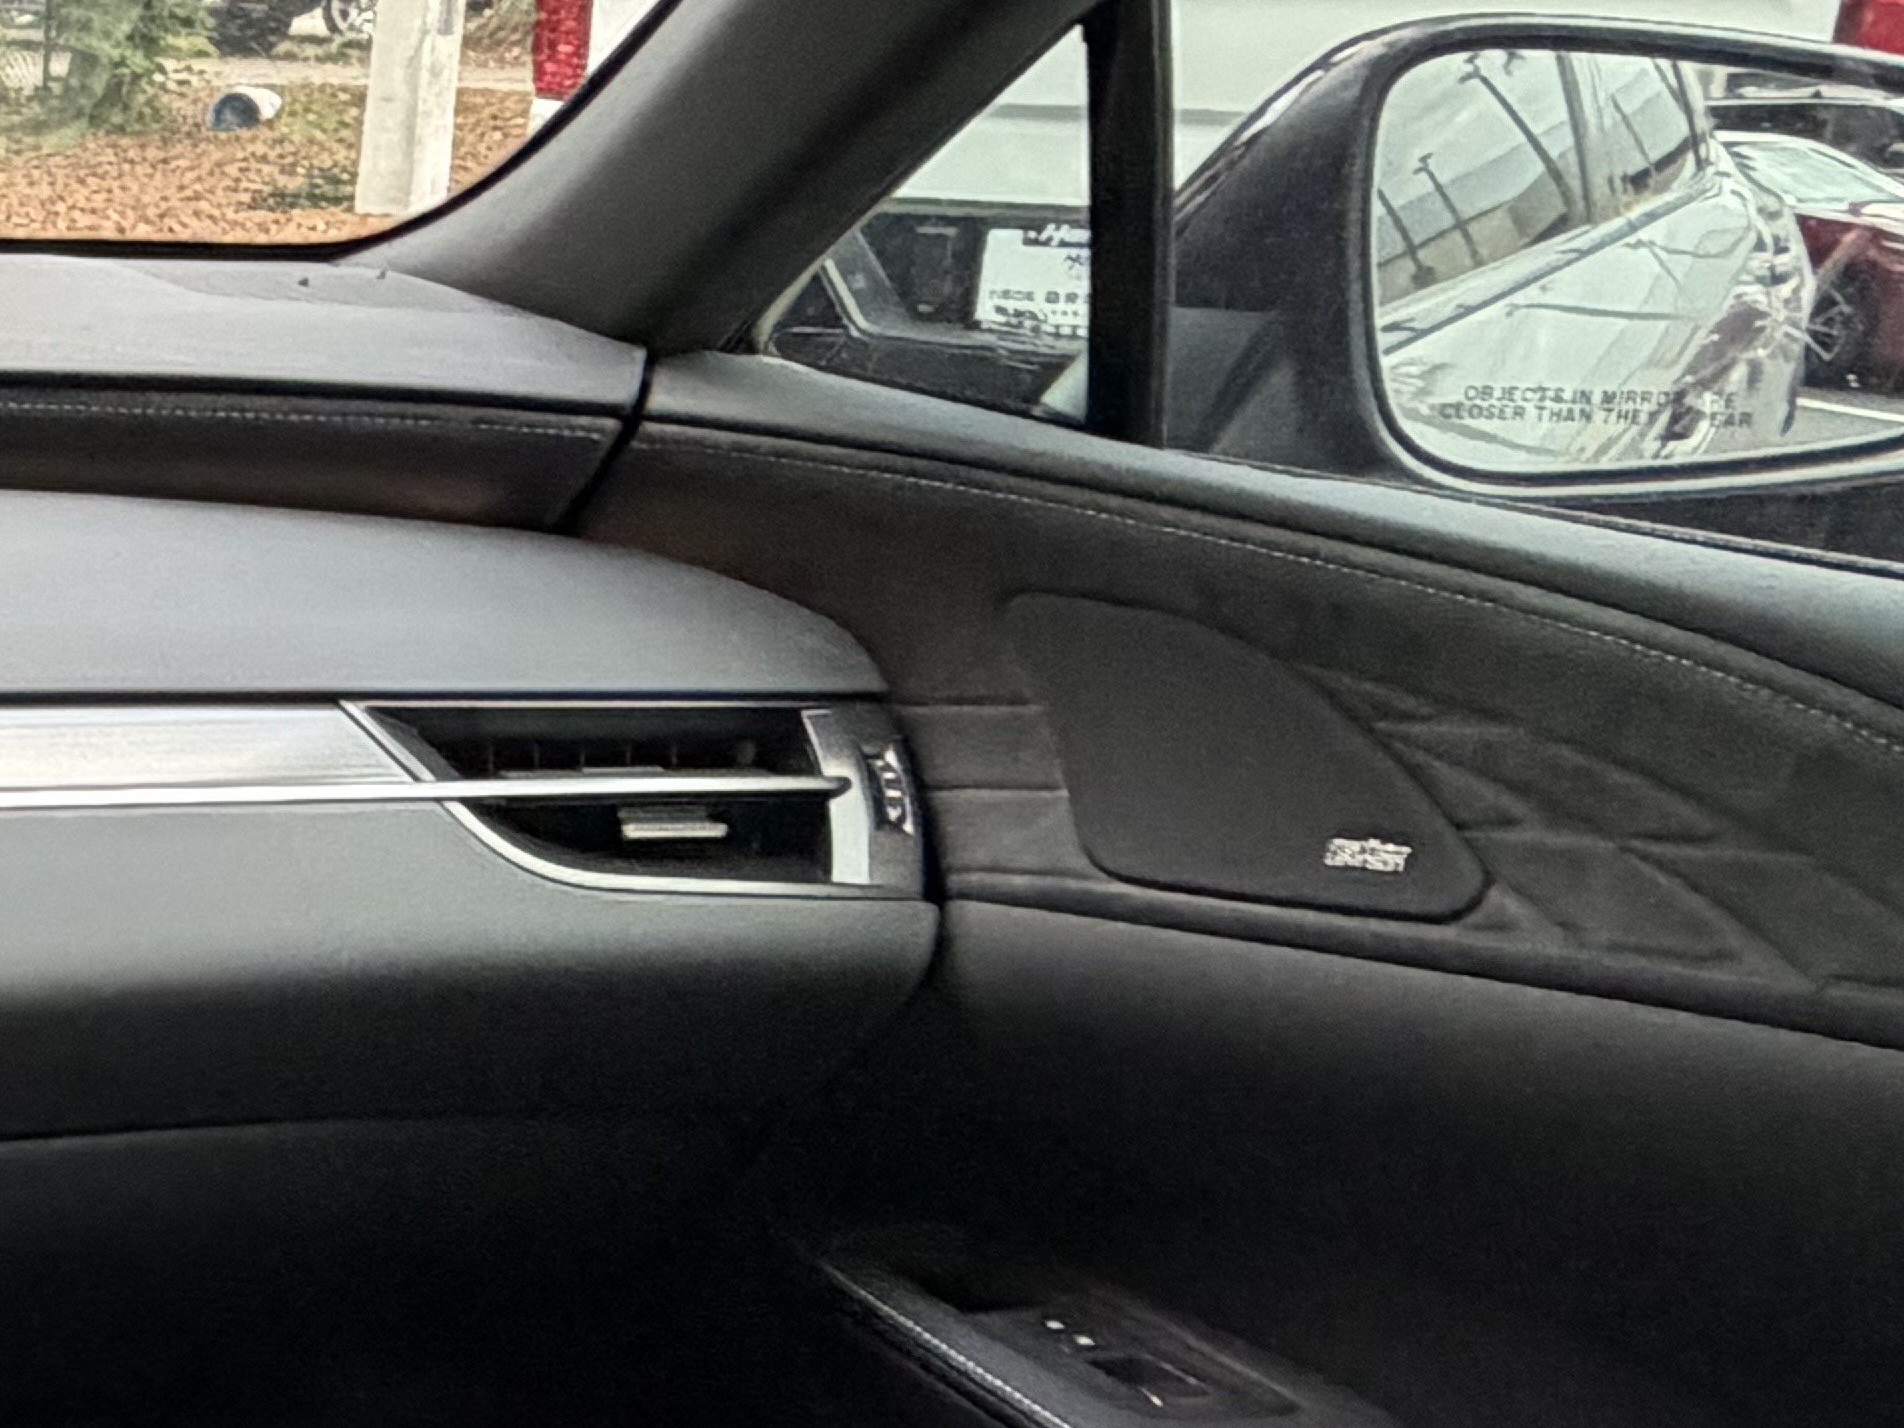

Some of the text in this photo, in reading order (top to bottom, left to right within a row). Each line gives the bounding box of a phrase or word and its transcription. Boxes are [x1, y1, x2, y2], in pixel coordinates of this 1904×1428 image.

[1464, 384, 1566, 405] OBJECTS
[1568, 388, 1594, 406] IN
[1441, 401, 1526, 422] CLOSER
[1535, 405, 1593, 424] THAN
